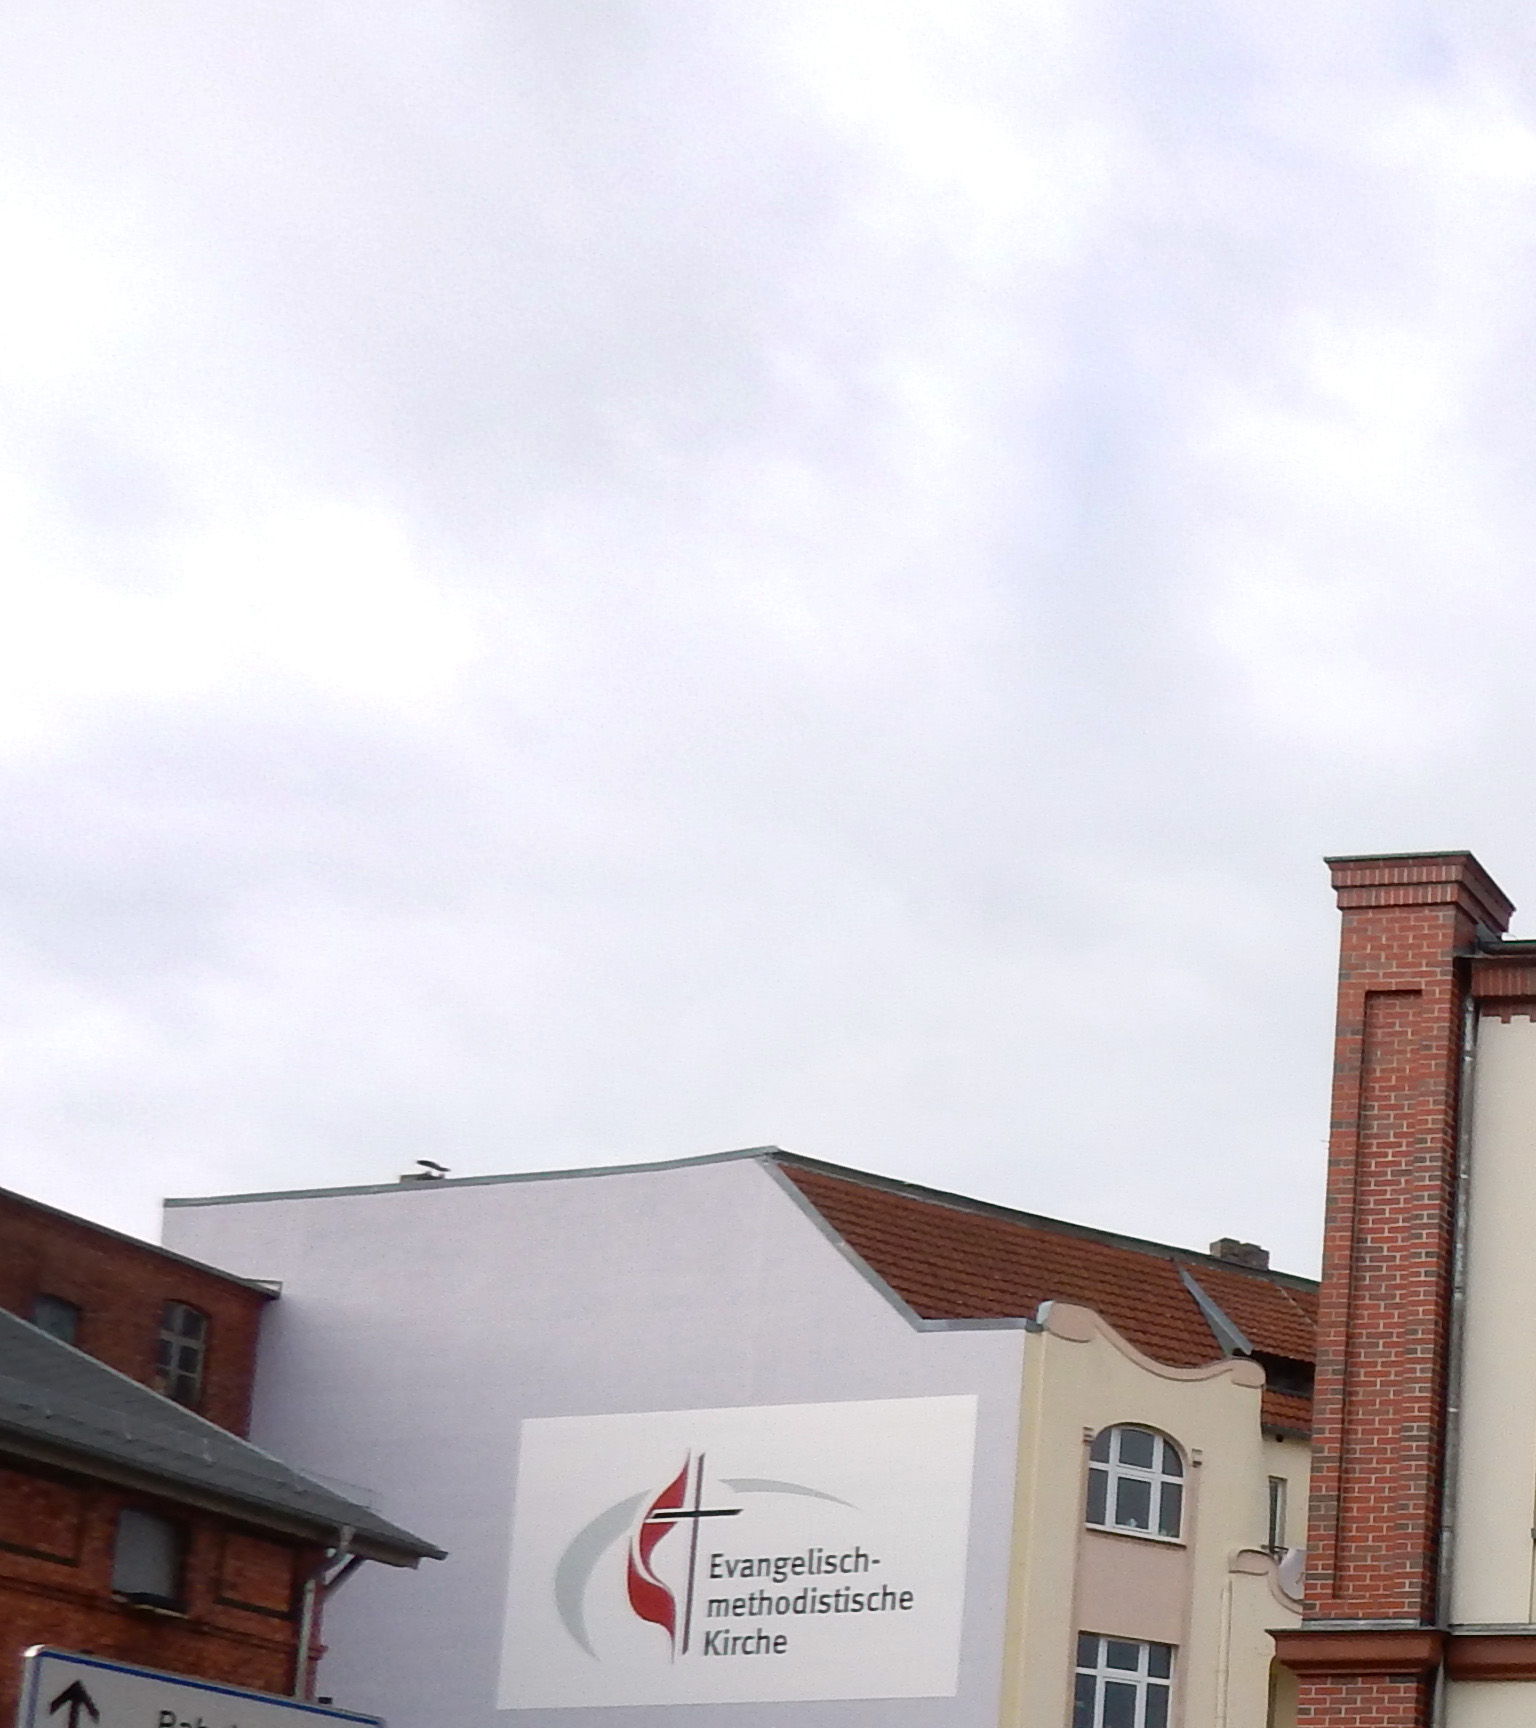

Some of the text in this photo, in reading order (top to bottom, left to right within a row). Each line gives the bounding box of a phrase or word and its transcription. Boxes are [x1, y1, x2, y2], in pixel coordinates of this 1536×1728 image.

[709, 1546, 881, 1583] Evangelisch-
[706, 1584, 914, 1618] methodistische
[703, 1627, 788, 1656] Kirche
